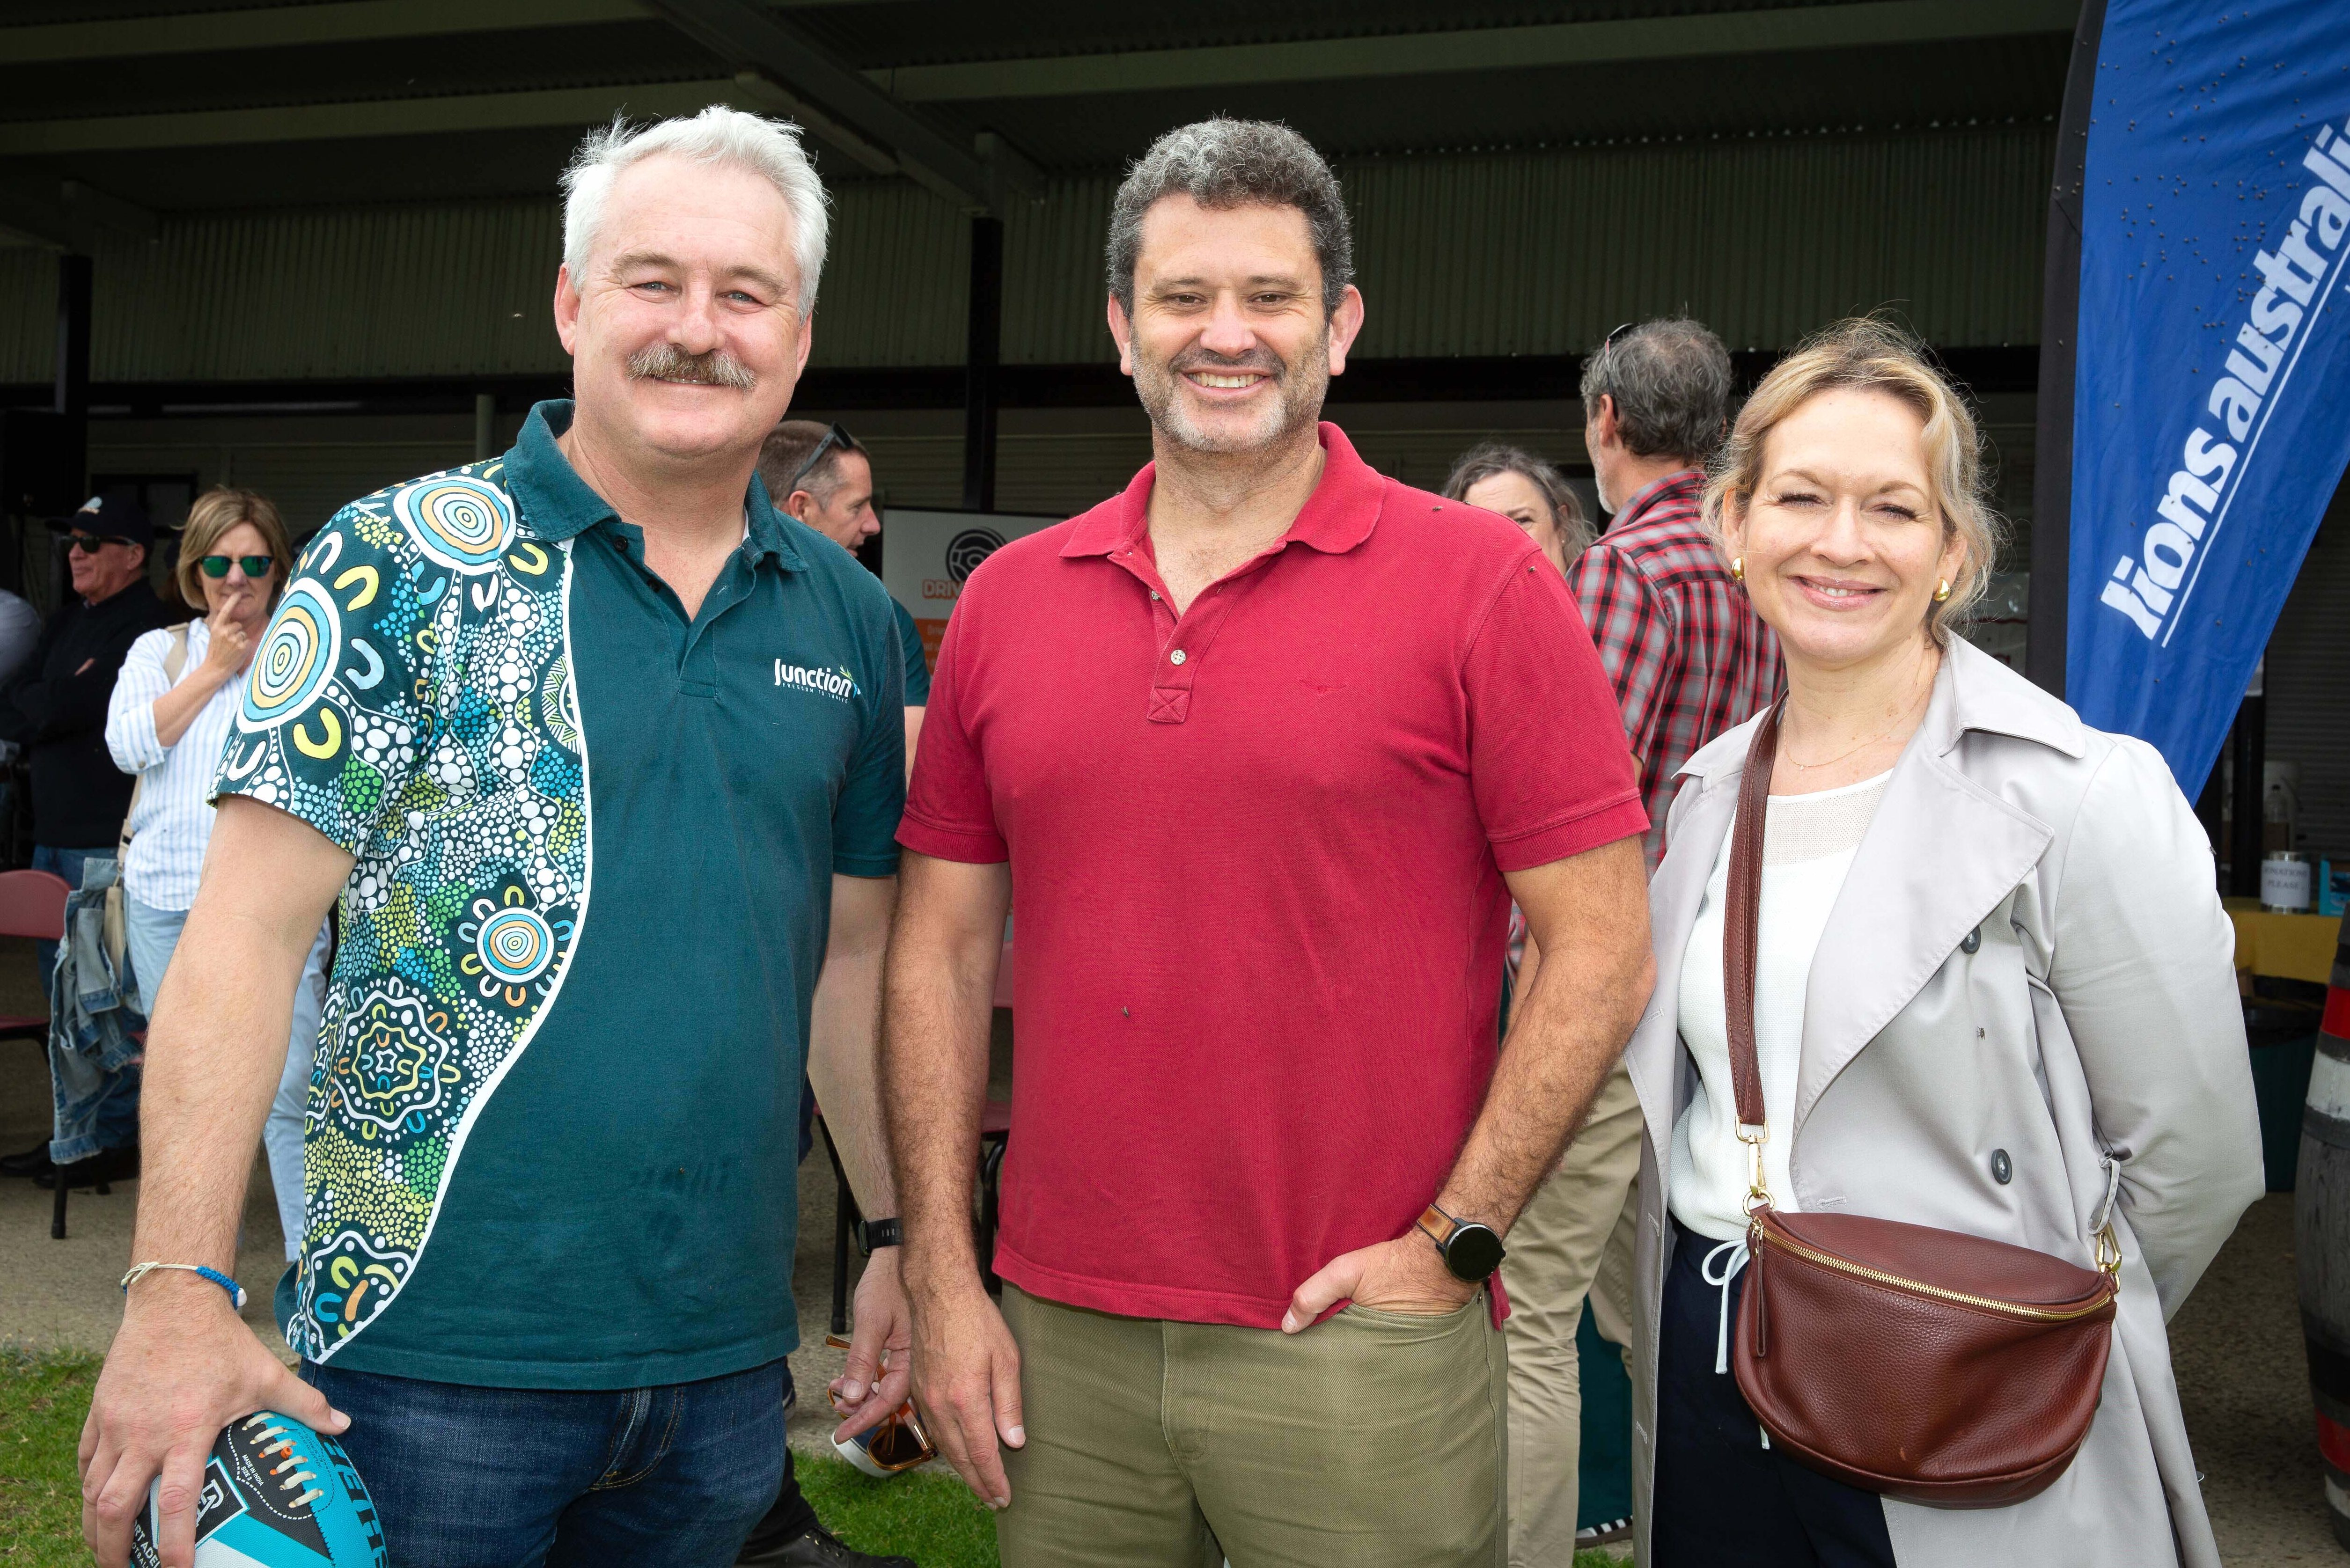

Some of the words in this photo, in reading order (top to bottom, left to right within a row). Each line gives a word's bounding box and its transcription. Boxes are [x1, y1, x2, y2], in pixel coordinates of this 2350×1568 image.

[2100, 427, 2238, 640] lions
[2208, 117, 2350, 443] australi
[774, 658, 852, 697] Junction
[782, 682, 814, 693] FREEDOM
[828, 693, 848, 704] THRIVE
[241, 1466, 250, 1478] SIZE
[242, 1454, 253, 1468] MADE
[253, 1473, 264, 1486] INDIA
